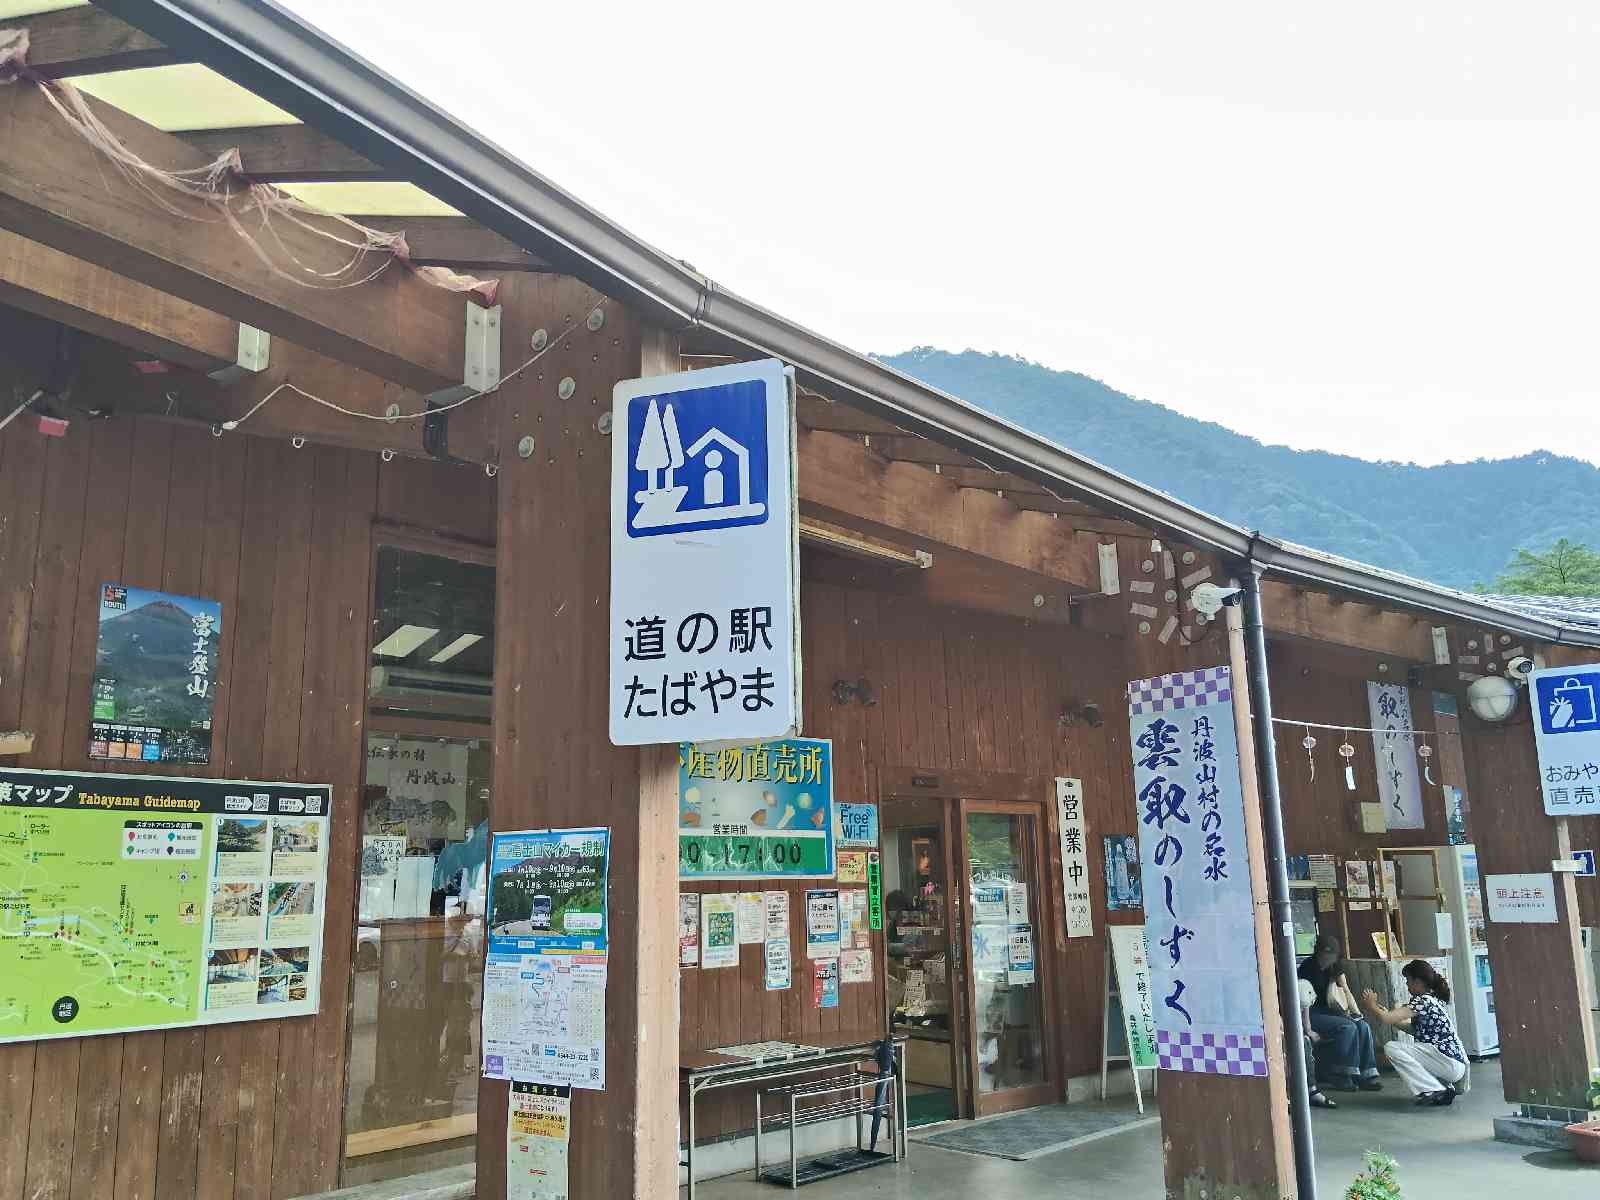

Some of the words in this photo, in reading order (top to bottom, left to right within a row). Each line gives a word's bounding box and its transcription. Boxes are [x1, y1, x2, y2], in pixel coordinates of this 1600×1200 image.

[186, 612, 214, 698] 富士登山
[624, 606, 773, 661] 道の駅
[624, 666, 775, 719] たばやま
[79, 792, 140, 808] Tabayama
[143, 795, 201, 811] Guidemap
[841, 809, 869, 824] Free
[1190, 715, 1229, 882] 丹波山村の名水
[1549, 785, 1600, 806] 直売
[712, 824, 748, 835] 営業時間
[1063, 794, 1083, 887] 営業中
[1136, 717, 1195, 1026] 雲取のしずく
